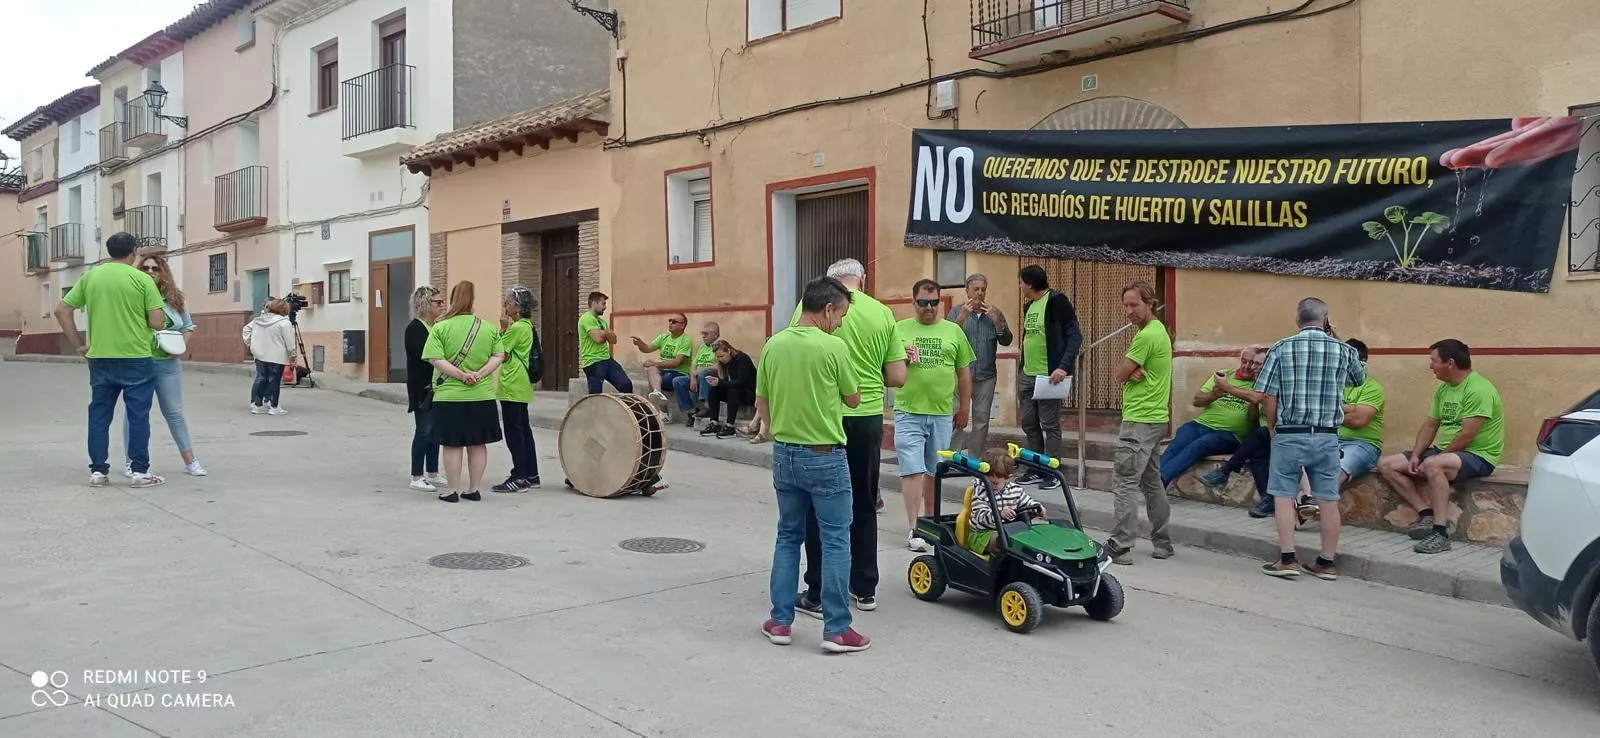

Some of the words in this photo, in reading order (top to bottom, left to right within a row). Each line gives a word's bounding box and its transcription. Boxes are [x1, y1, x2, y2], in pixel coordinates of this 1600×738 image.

[913, 145, 975, 224] NO
[983, 156, 1070, 181] QUEREMOS
[1070, 158, 1103, 182] QUE
[1106, 158, 1131, 183] SE
[1132, 159, 1230, 184] DESTROCE
[1232, 158, 1331, 185] NUESTRO
[1333, 156, 1434, 189] FUTURO,
[983, 191, 1007, 215] LOS
[1011, 189, 1085, 219] REGADÍOS
[1089, 195, 1109, 220] DE
[1115, 196, 1186, 224] HUERTO
[1192, 199, 1205, 225] Y
[1208, 199, 1308, 228] SALILLAS
